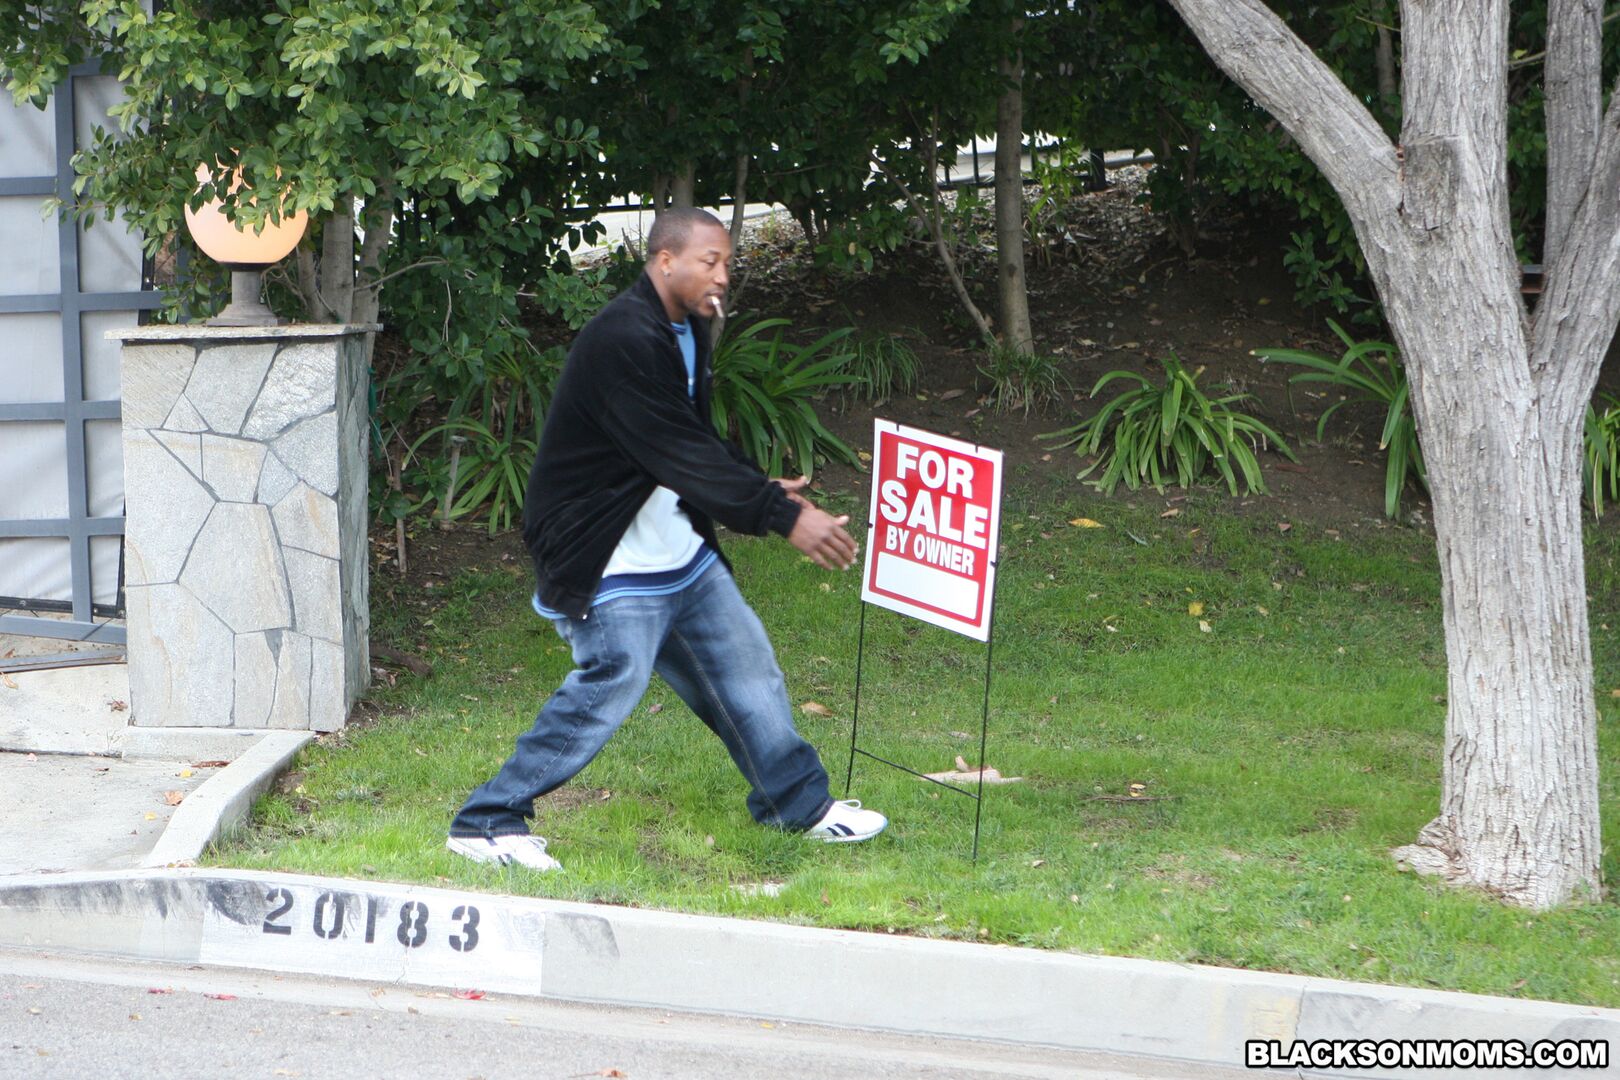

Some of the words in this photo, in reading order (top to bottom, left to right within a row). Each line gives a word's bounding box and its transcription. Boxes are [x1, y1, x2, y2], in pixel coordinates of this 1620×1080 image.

[896, 442, 974, 499] FOR
[880, 480, 988, 549] SALE
[886, 524, 909, 554] BY
[913, 534, 975, 576] OWNER
[262, 887, 480, 952] 20183
